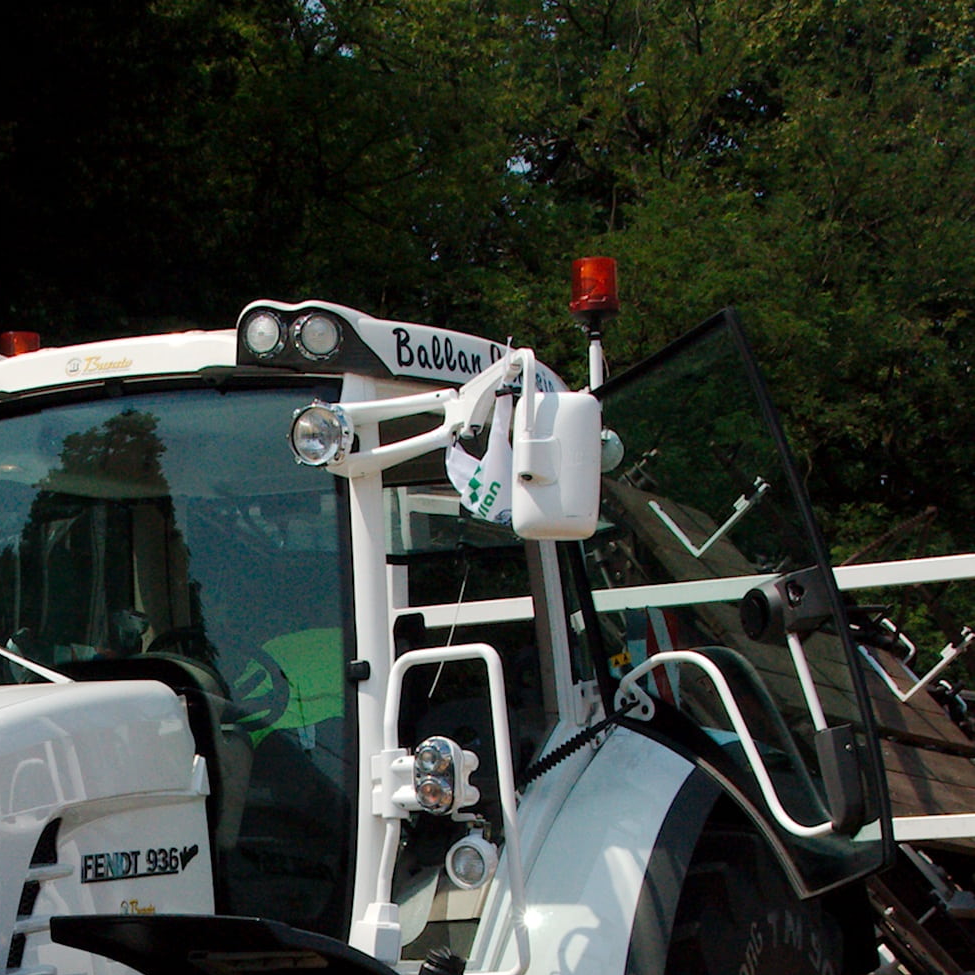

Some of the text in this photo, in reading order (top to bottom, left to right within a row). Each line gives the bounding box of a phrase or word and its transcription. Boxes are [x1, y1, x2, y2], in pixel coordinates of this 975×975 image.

[392, 327, 482, 375] Ballan
[82, 851, 140, 880] FENDT
[146, 847, 179, 873] 936
